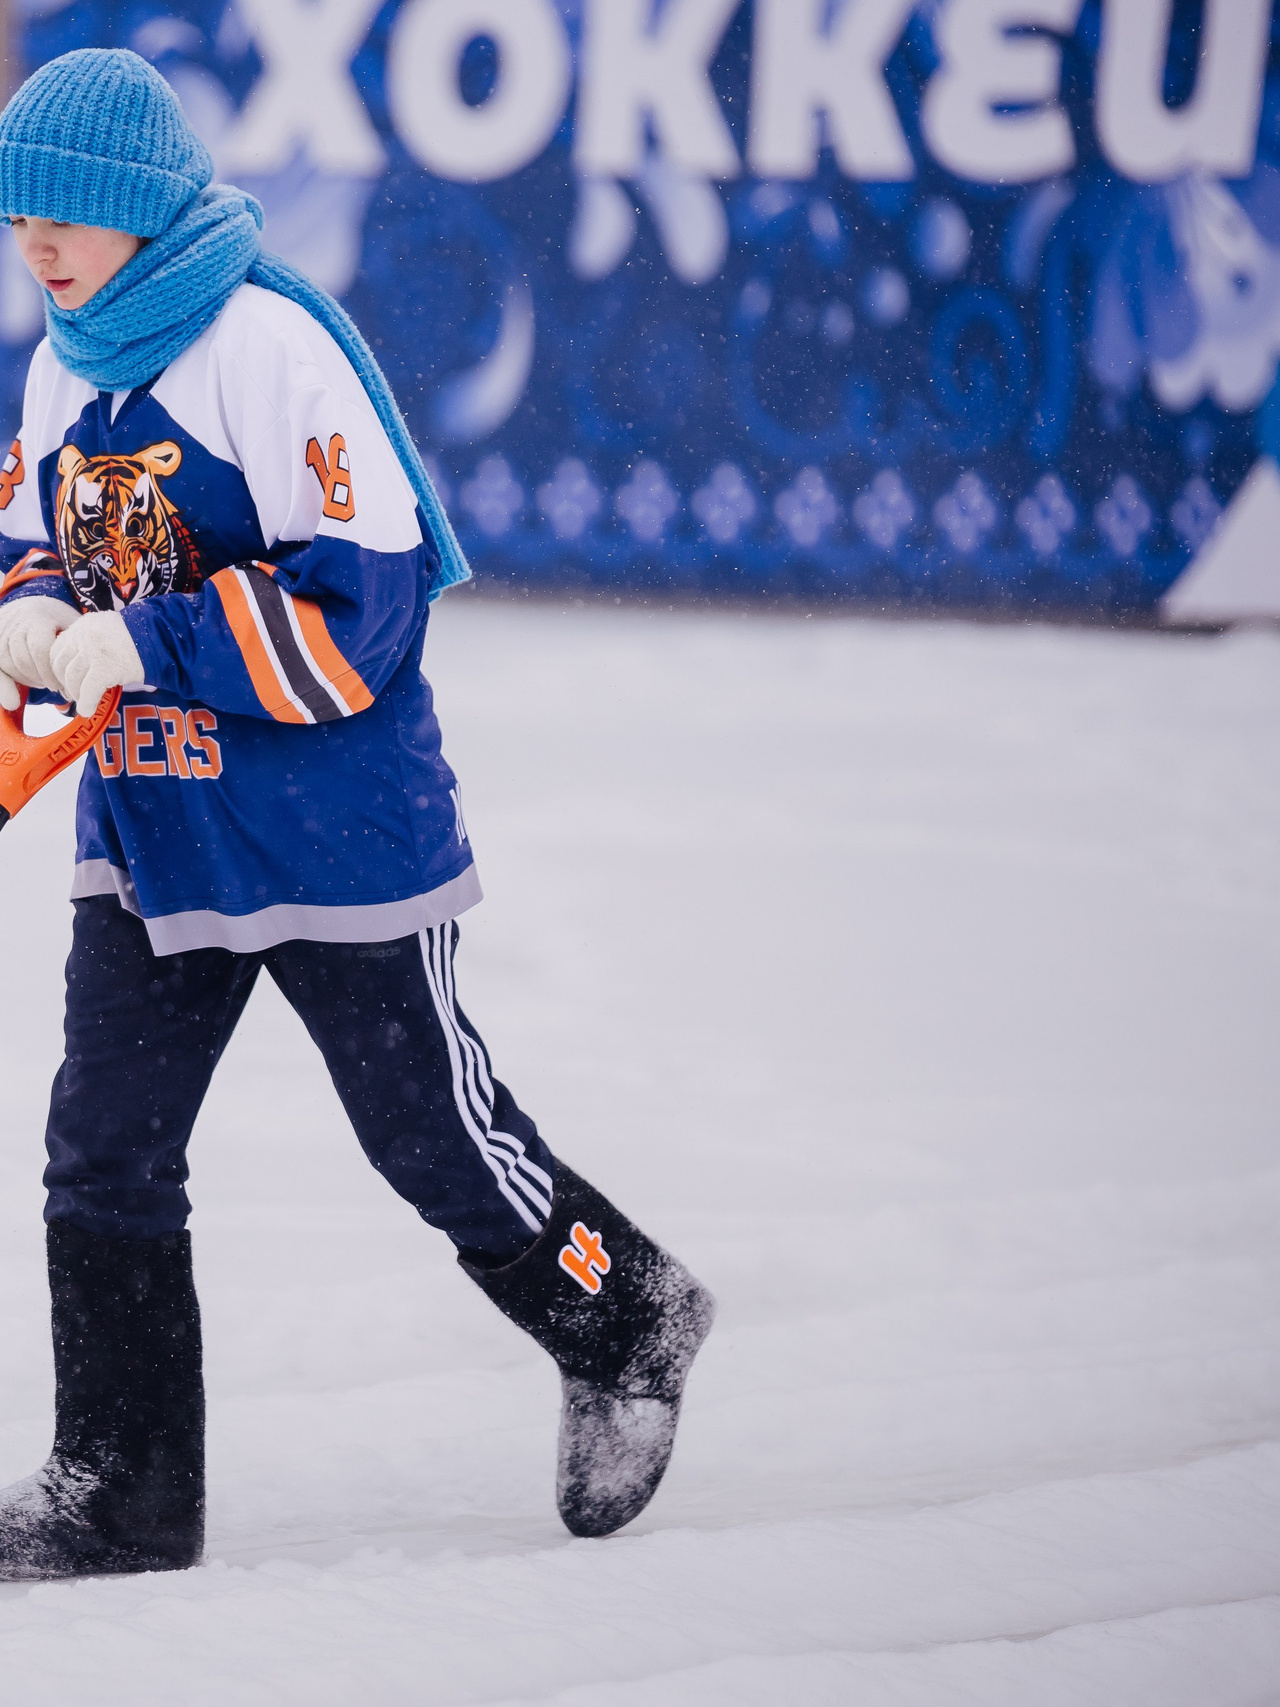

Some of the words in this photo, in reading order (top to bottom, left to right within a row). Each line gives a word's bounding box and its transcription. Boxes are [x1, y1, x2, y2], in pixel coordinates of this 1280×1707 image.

[306, 432, 355, 523] 18
[93, 704, 223, 780] GERS
[357, 946, 401, 958] adidas
